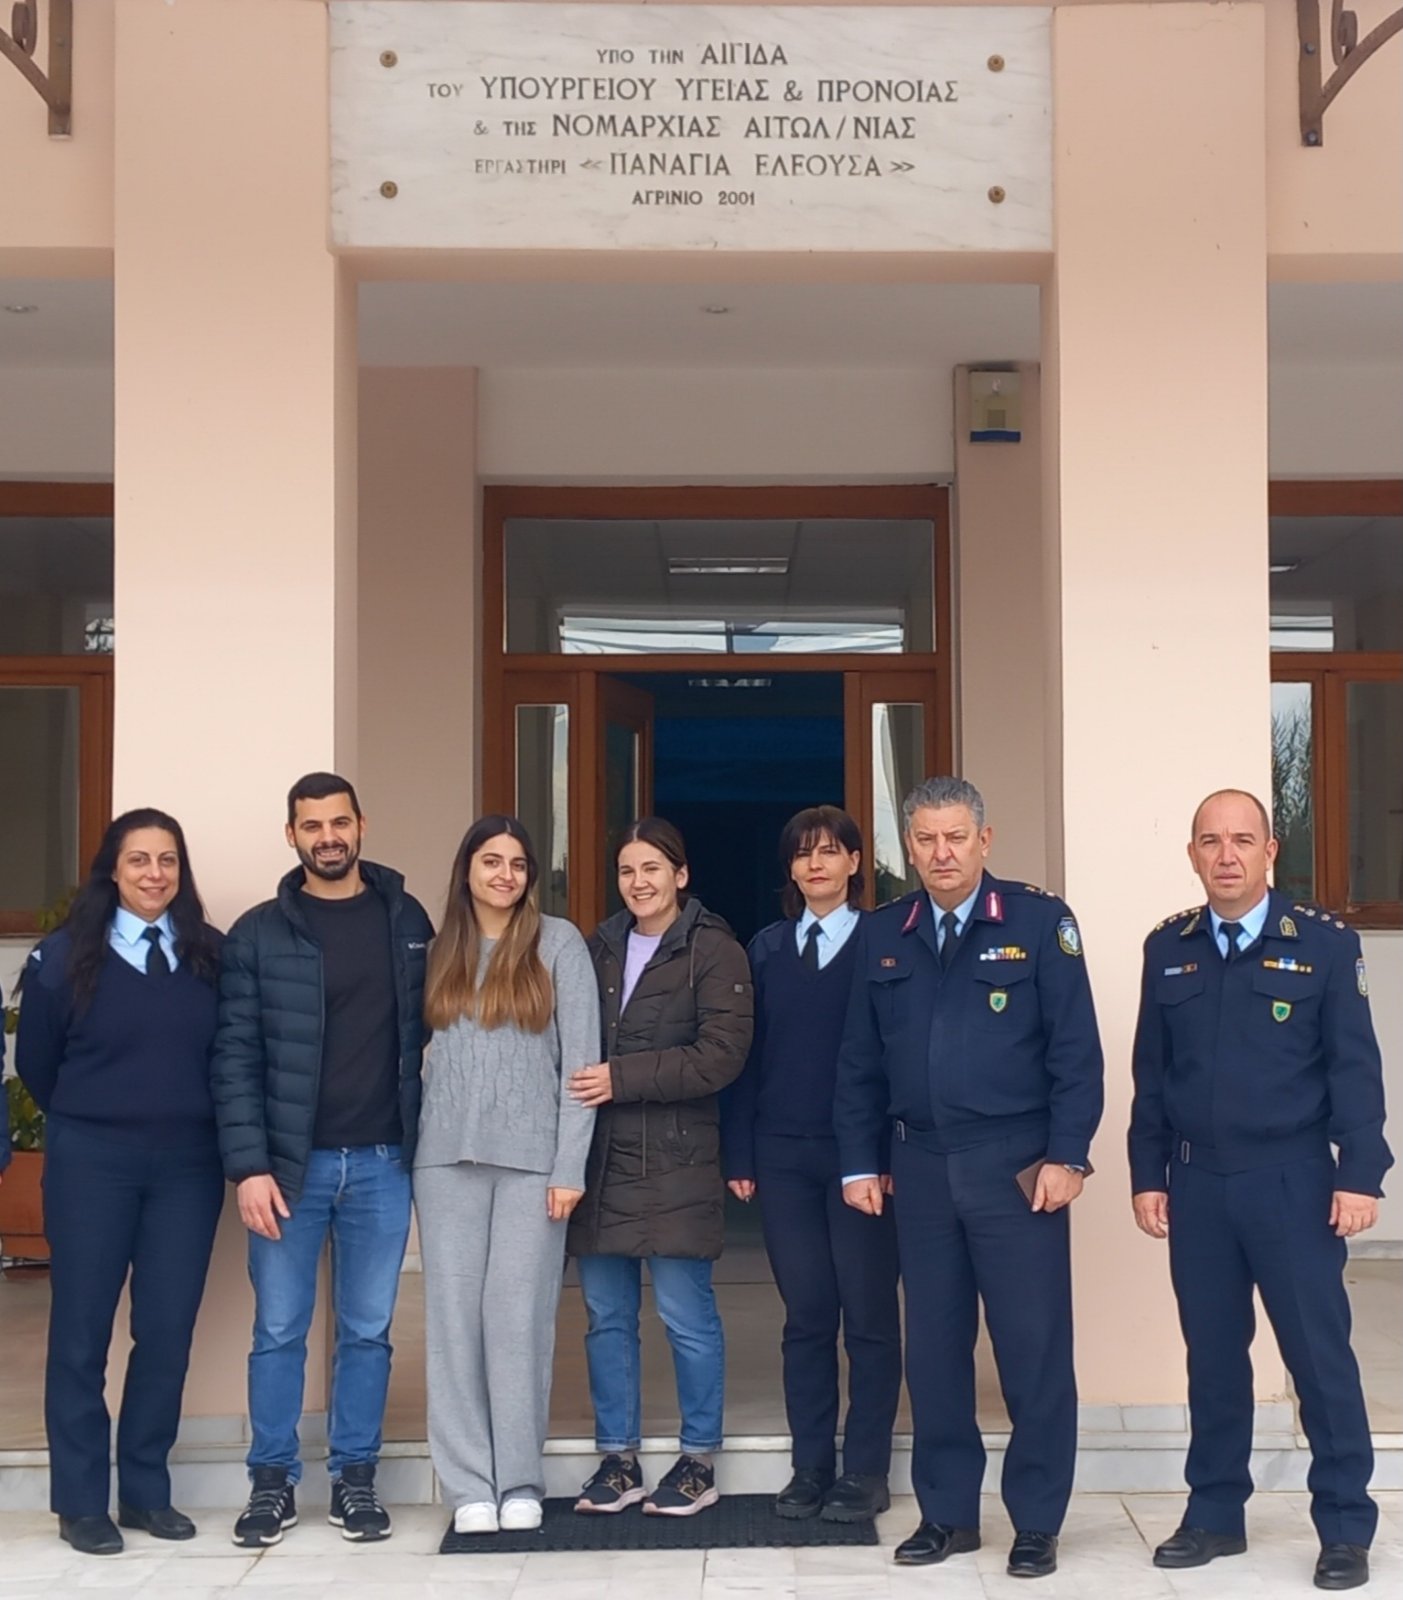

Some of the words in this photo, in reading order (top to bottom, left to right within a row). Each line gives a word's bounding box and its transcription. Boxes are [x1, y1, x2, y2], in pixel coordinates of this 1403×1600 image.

[597, 49, 635, 64] ΥΠΟ
[649, 49, 684, 64] ΤΗΝ
[701, 42, 788, 65] ΑΙΓΙΔΑ
[427, 83, 464, 98] ΤΟΥ
[480, 76, 657, 101] ΥΠΟΥΡΓΕΙΟΥ
[675, 78, 770, 101] ΥΓΕΙΑΣ
[783, 80, 804, 102] &
[818, 80, 959, 102] ΠΡΟΝΟΙΑΣ
[473, 120, 489, 135] &
[503, 120, 537, 135] ΤΗΣ
[552, 114, 722, 138] ΝΟΜΑΡΧΙΑΣ
[744, 116, 917, 140] ΑΙΤΩΛ/ΝΙΑΣ
[475, 159, 567, 174] ΕΡΓΑΣΤΗΡΙ
[631, 190, 704, 206] ΑΓΡΙΝΙΟ
[717, 190, 755, 206] 2001
